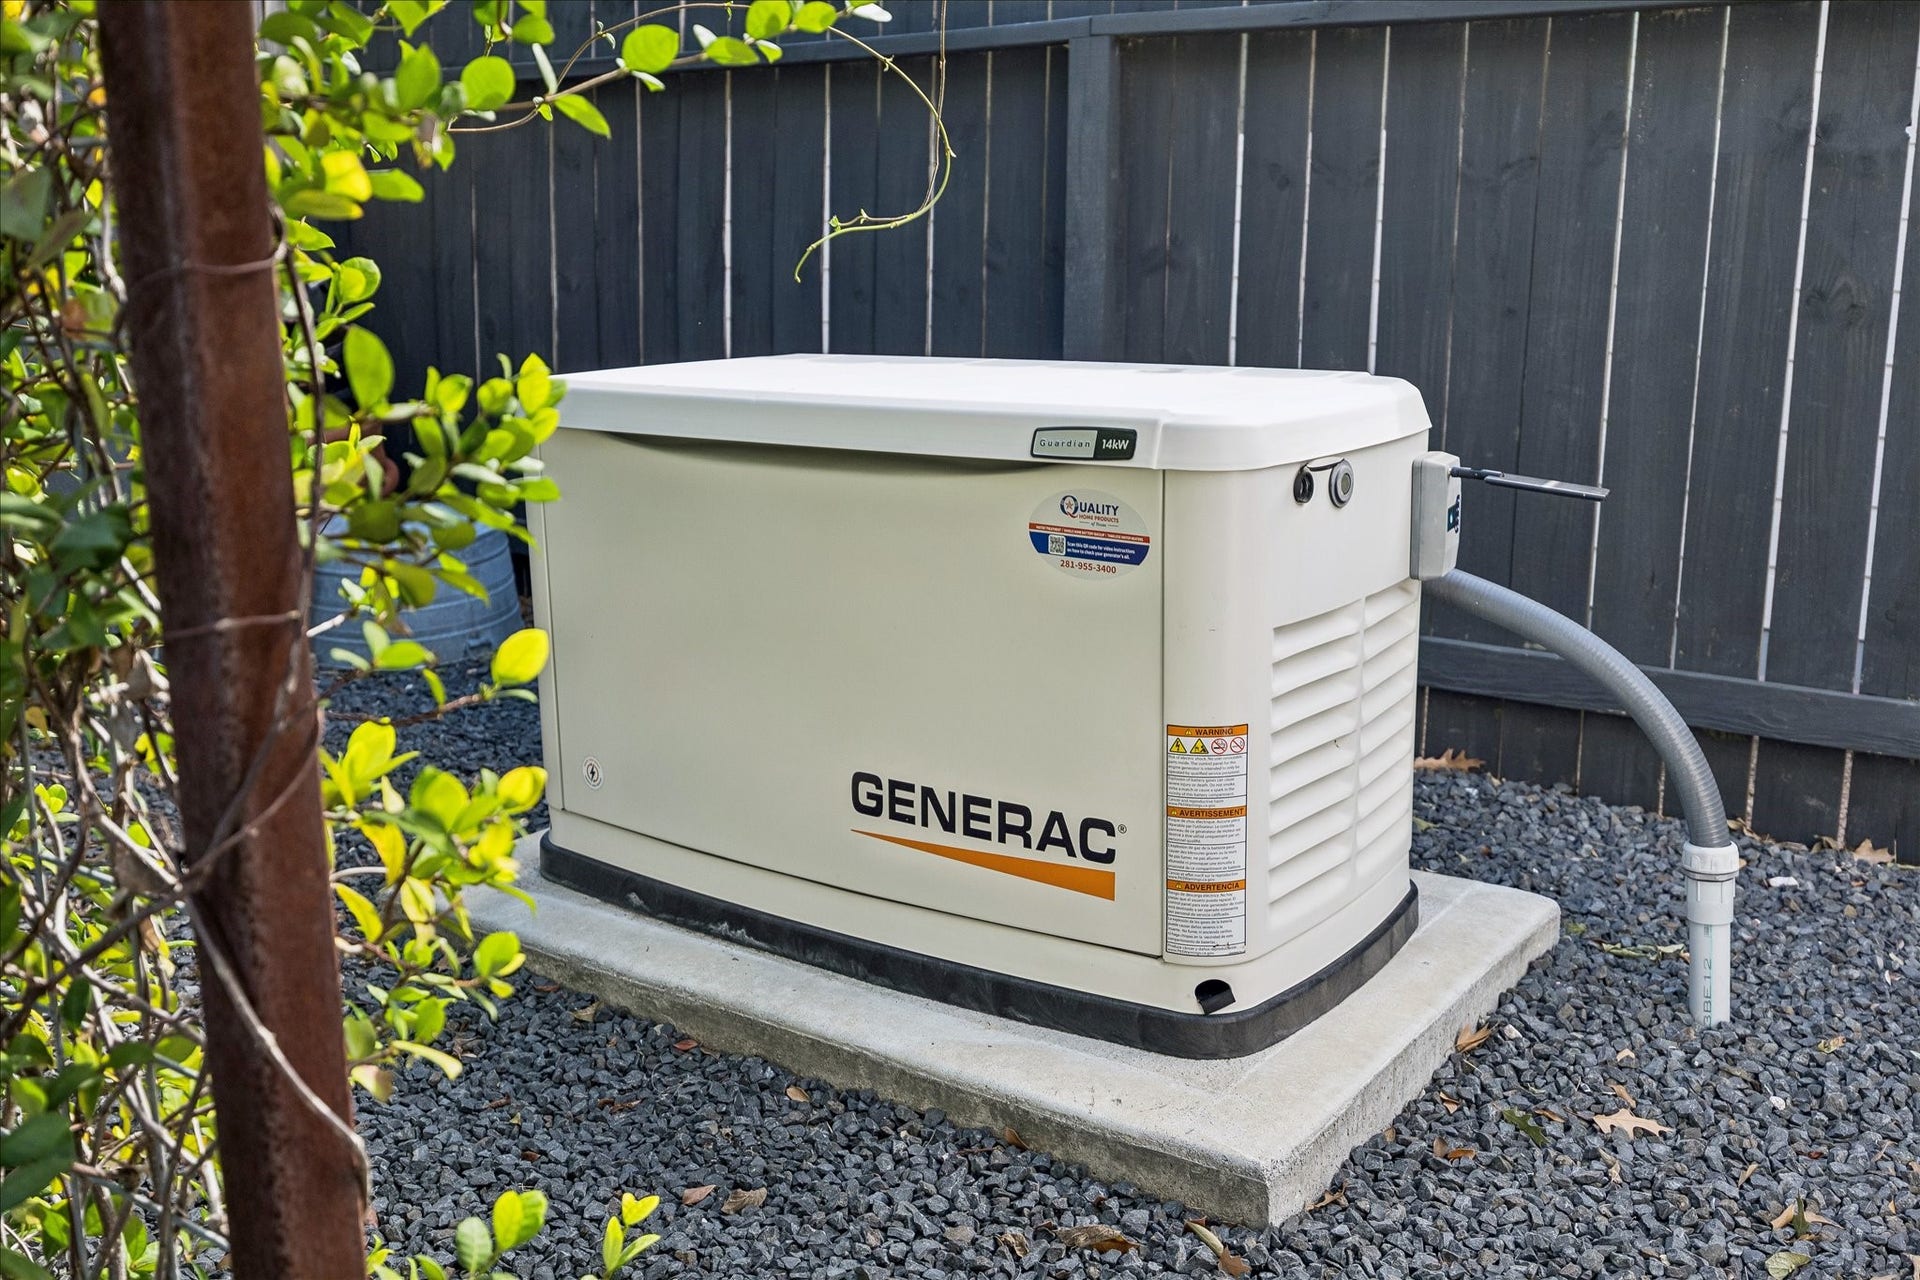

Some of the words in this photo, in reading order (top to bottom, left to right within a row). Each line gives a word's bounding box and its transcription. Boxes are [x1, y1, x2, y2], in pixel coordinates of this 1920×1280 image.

[1039, 439, 1091, 448] Guardian
[1102, 438, 1130, 450] 14kW
[1060, 494, 1119, 519] QUALITY
[1094, 515, 1119, 524] PRODUCTS
[1060, 559, 1117, 574] 281-955-3400
[1195, 728, 1233, 736] WARNING
[1179, 808, 1244, 818] AVERTISSEMENT
[1184, 883, 1240, 892] ADVERTENCIA
